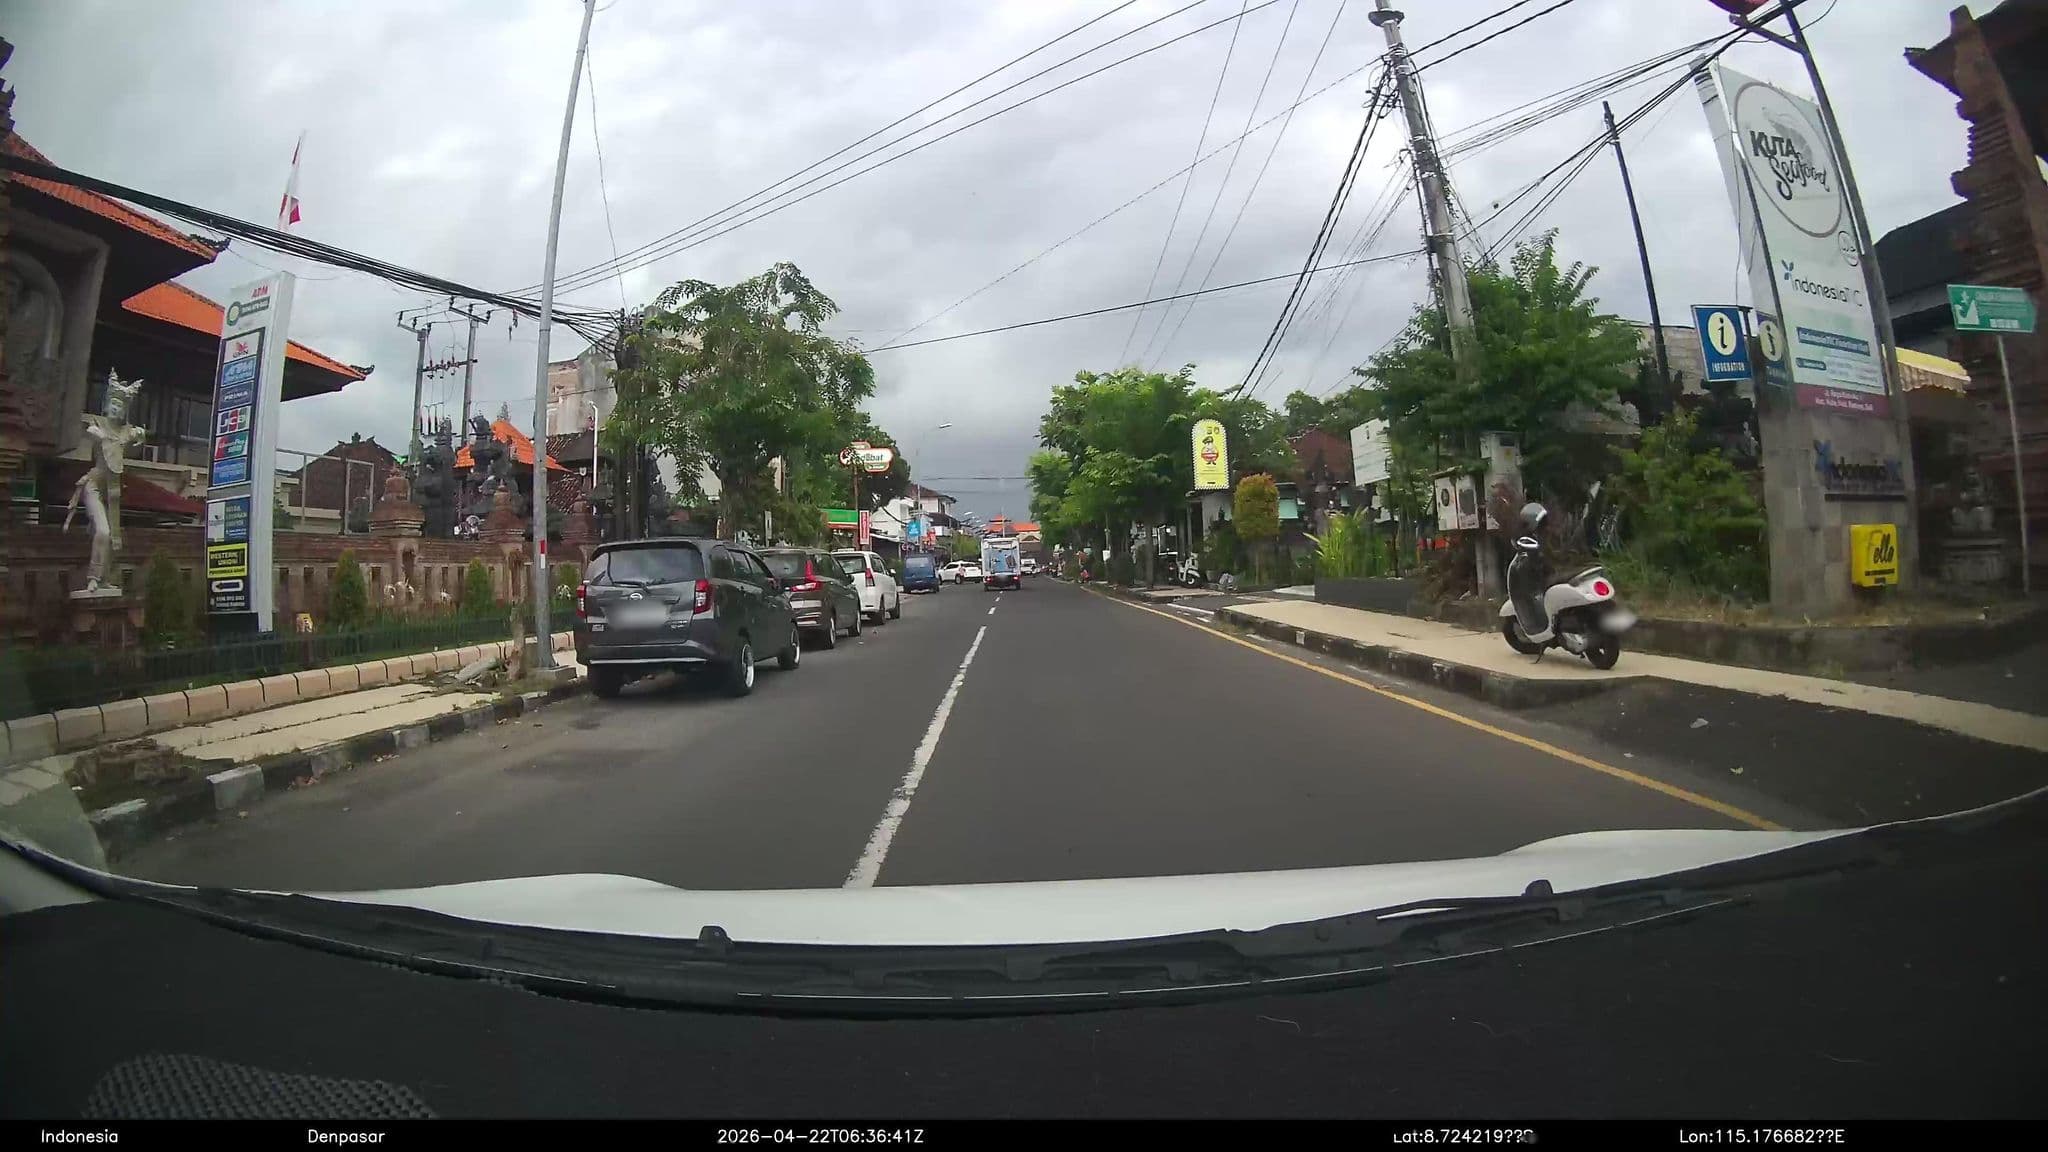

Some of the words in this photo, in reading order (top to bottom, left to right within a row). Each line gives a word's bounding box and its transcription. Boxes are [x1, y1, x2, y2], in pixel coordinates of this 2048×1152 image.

[1750, 131, 1796, 157] KUTA
[1769, 152, 1831, 200] Seafood
[1711, 362, 1745, 373] INFORMATION
[224, 390, 249, 401] PRIMA
